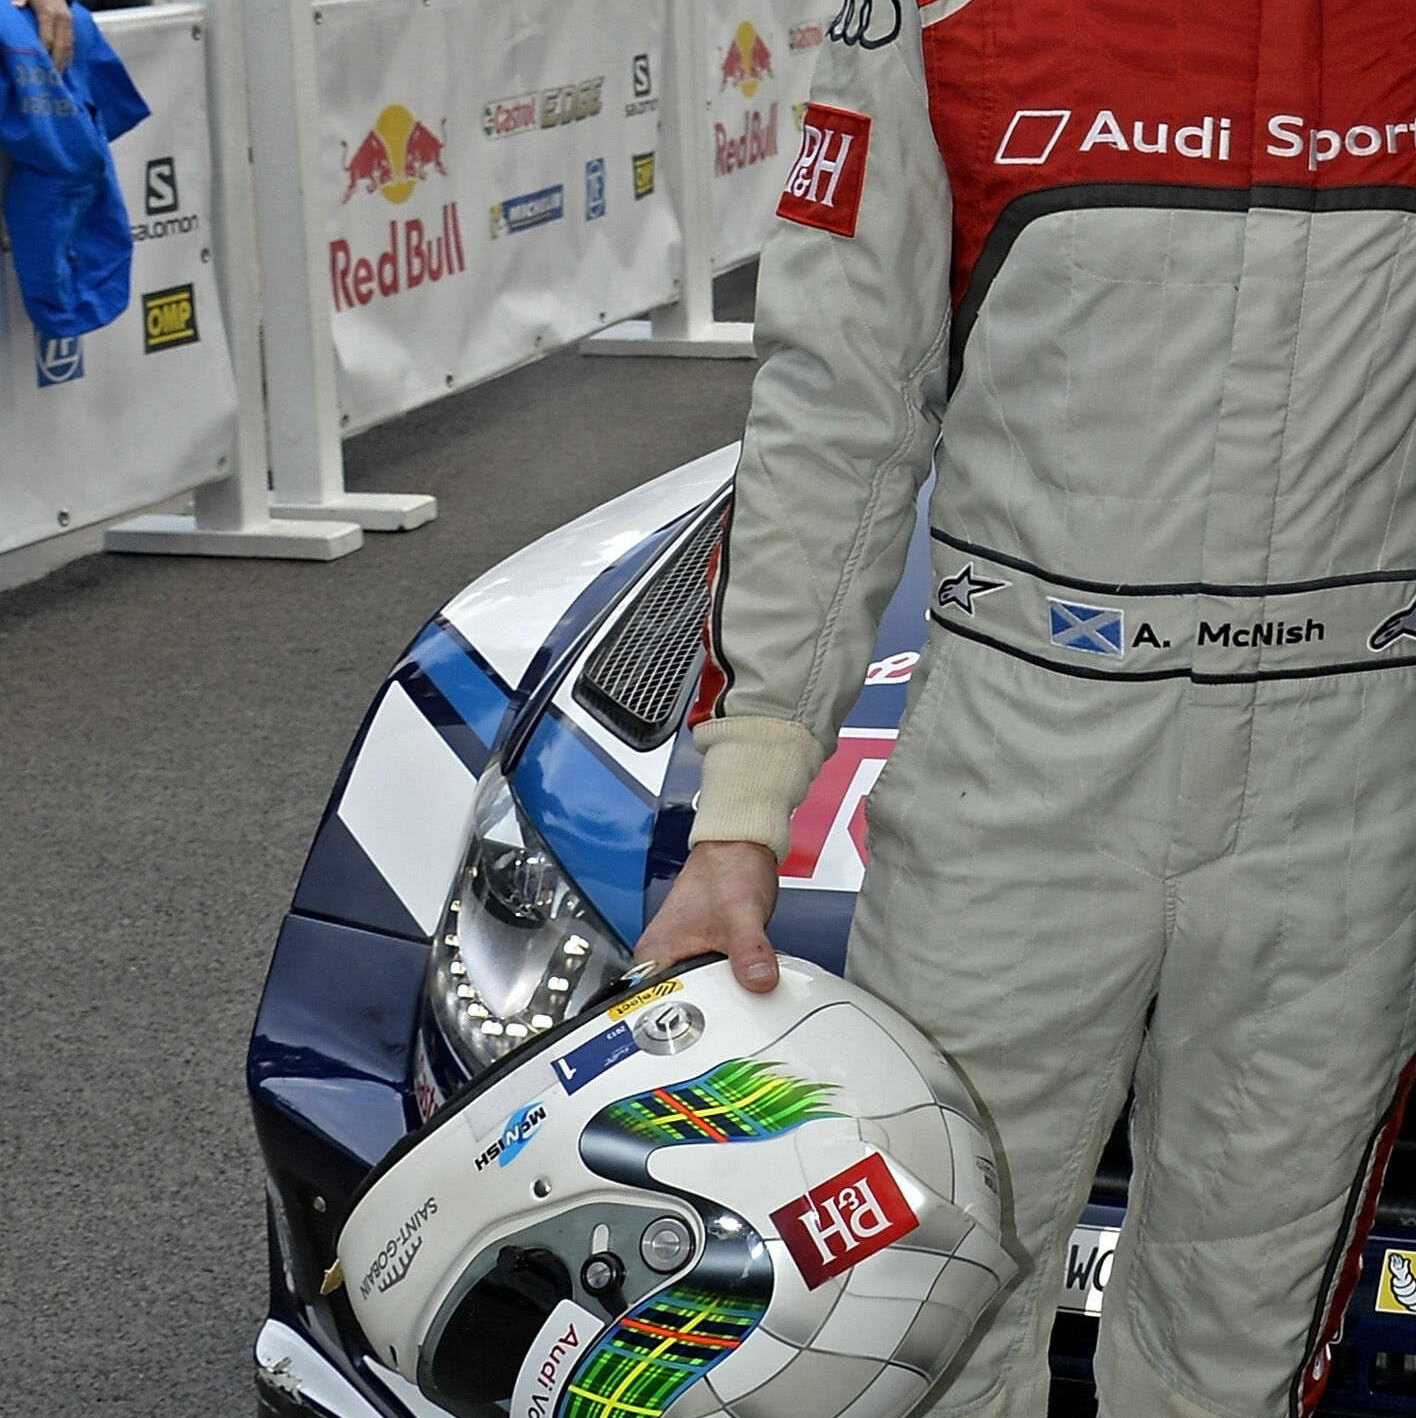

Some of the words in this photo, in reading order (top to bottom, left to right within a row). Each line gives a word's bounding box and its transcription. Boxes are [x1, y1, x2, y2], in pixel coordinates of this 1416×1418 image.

[714, 111, 749, 177] Red
[749, 102, 778, 164] Bull
[1080, 111, 1231, 165] Audi
[329, 220, 400, 312] Red
[405, 202, 466, 289] Bull
[147, 301, 193, 337] OMP
[1132, 621, 1171, 649] A.
[1198, 618, 1325, 648] McNish
[616, 992, 652, 1014] eject
[359, 1196, 438, 1301] SAINT-GOBAIN
[537, 1323, 580, 1392] Audi
